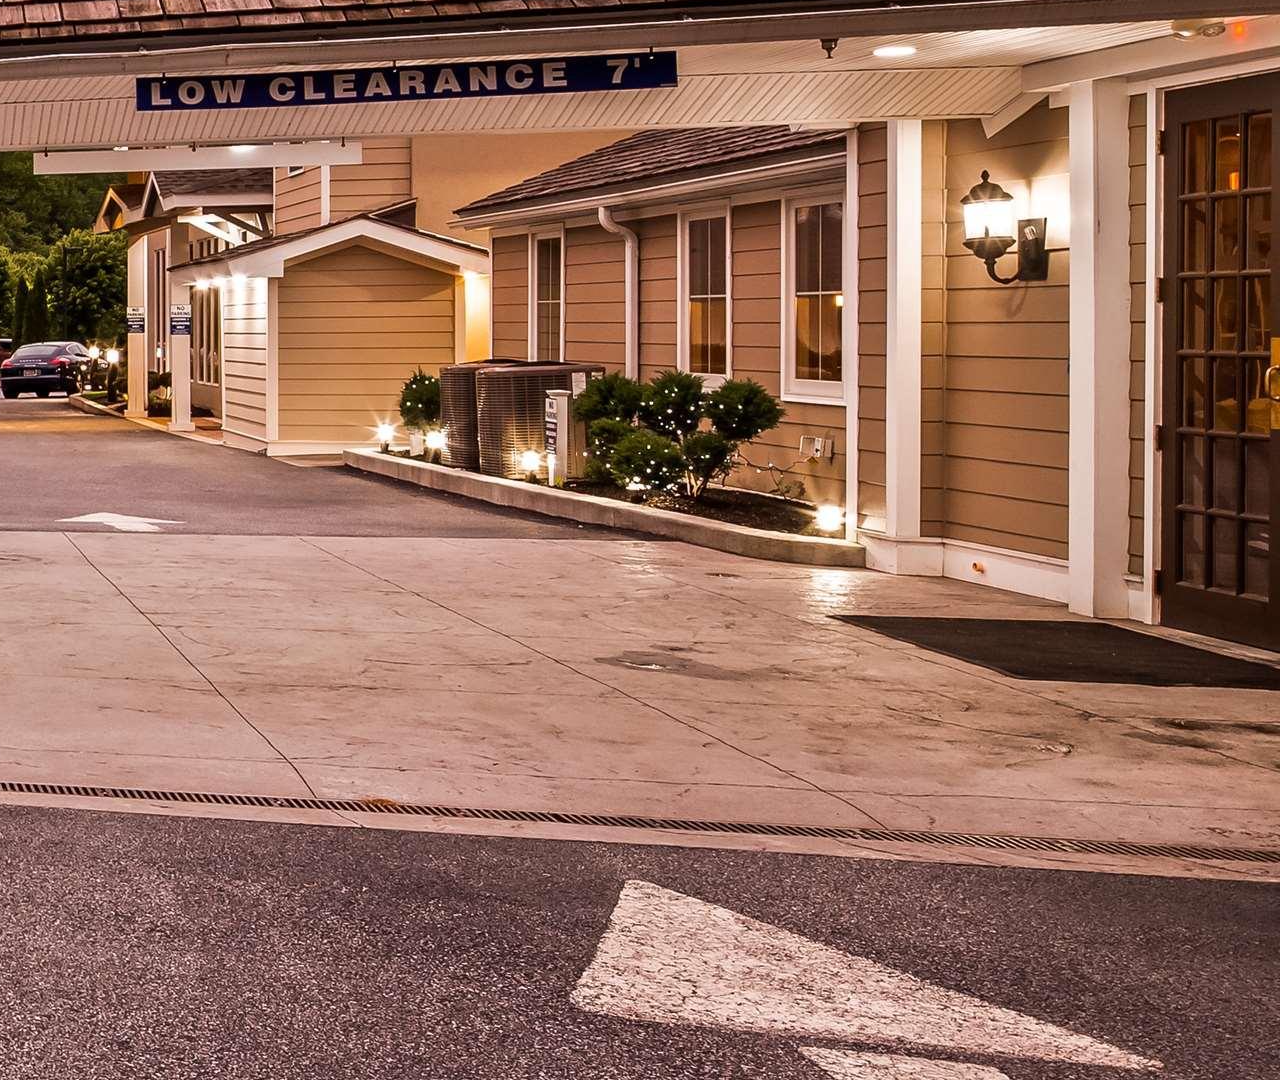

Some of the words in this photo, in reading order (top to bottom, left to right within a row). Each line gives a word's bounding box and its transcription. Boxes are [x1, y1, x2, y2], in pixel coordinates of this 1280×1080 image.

[151, 79, 245, 106] LOW
[268, 61, 568, 102] CLEARANCE
[606, 57, 641, 84] 7'
